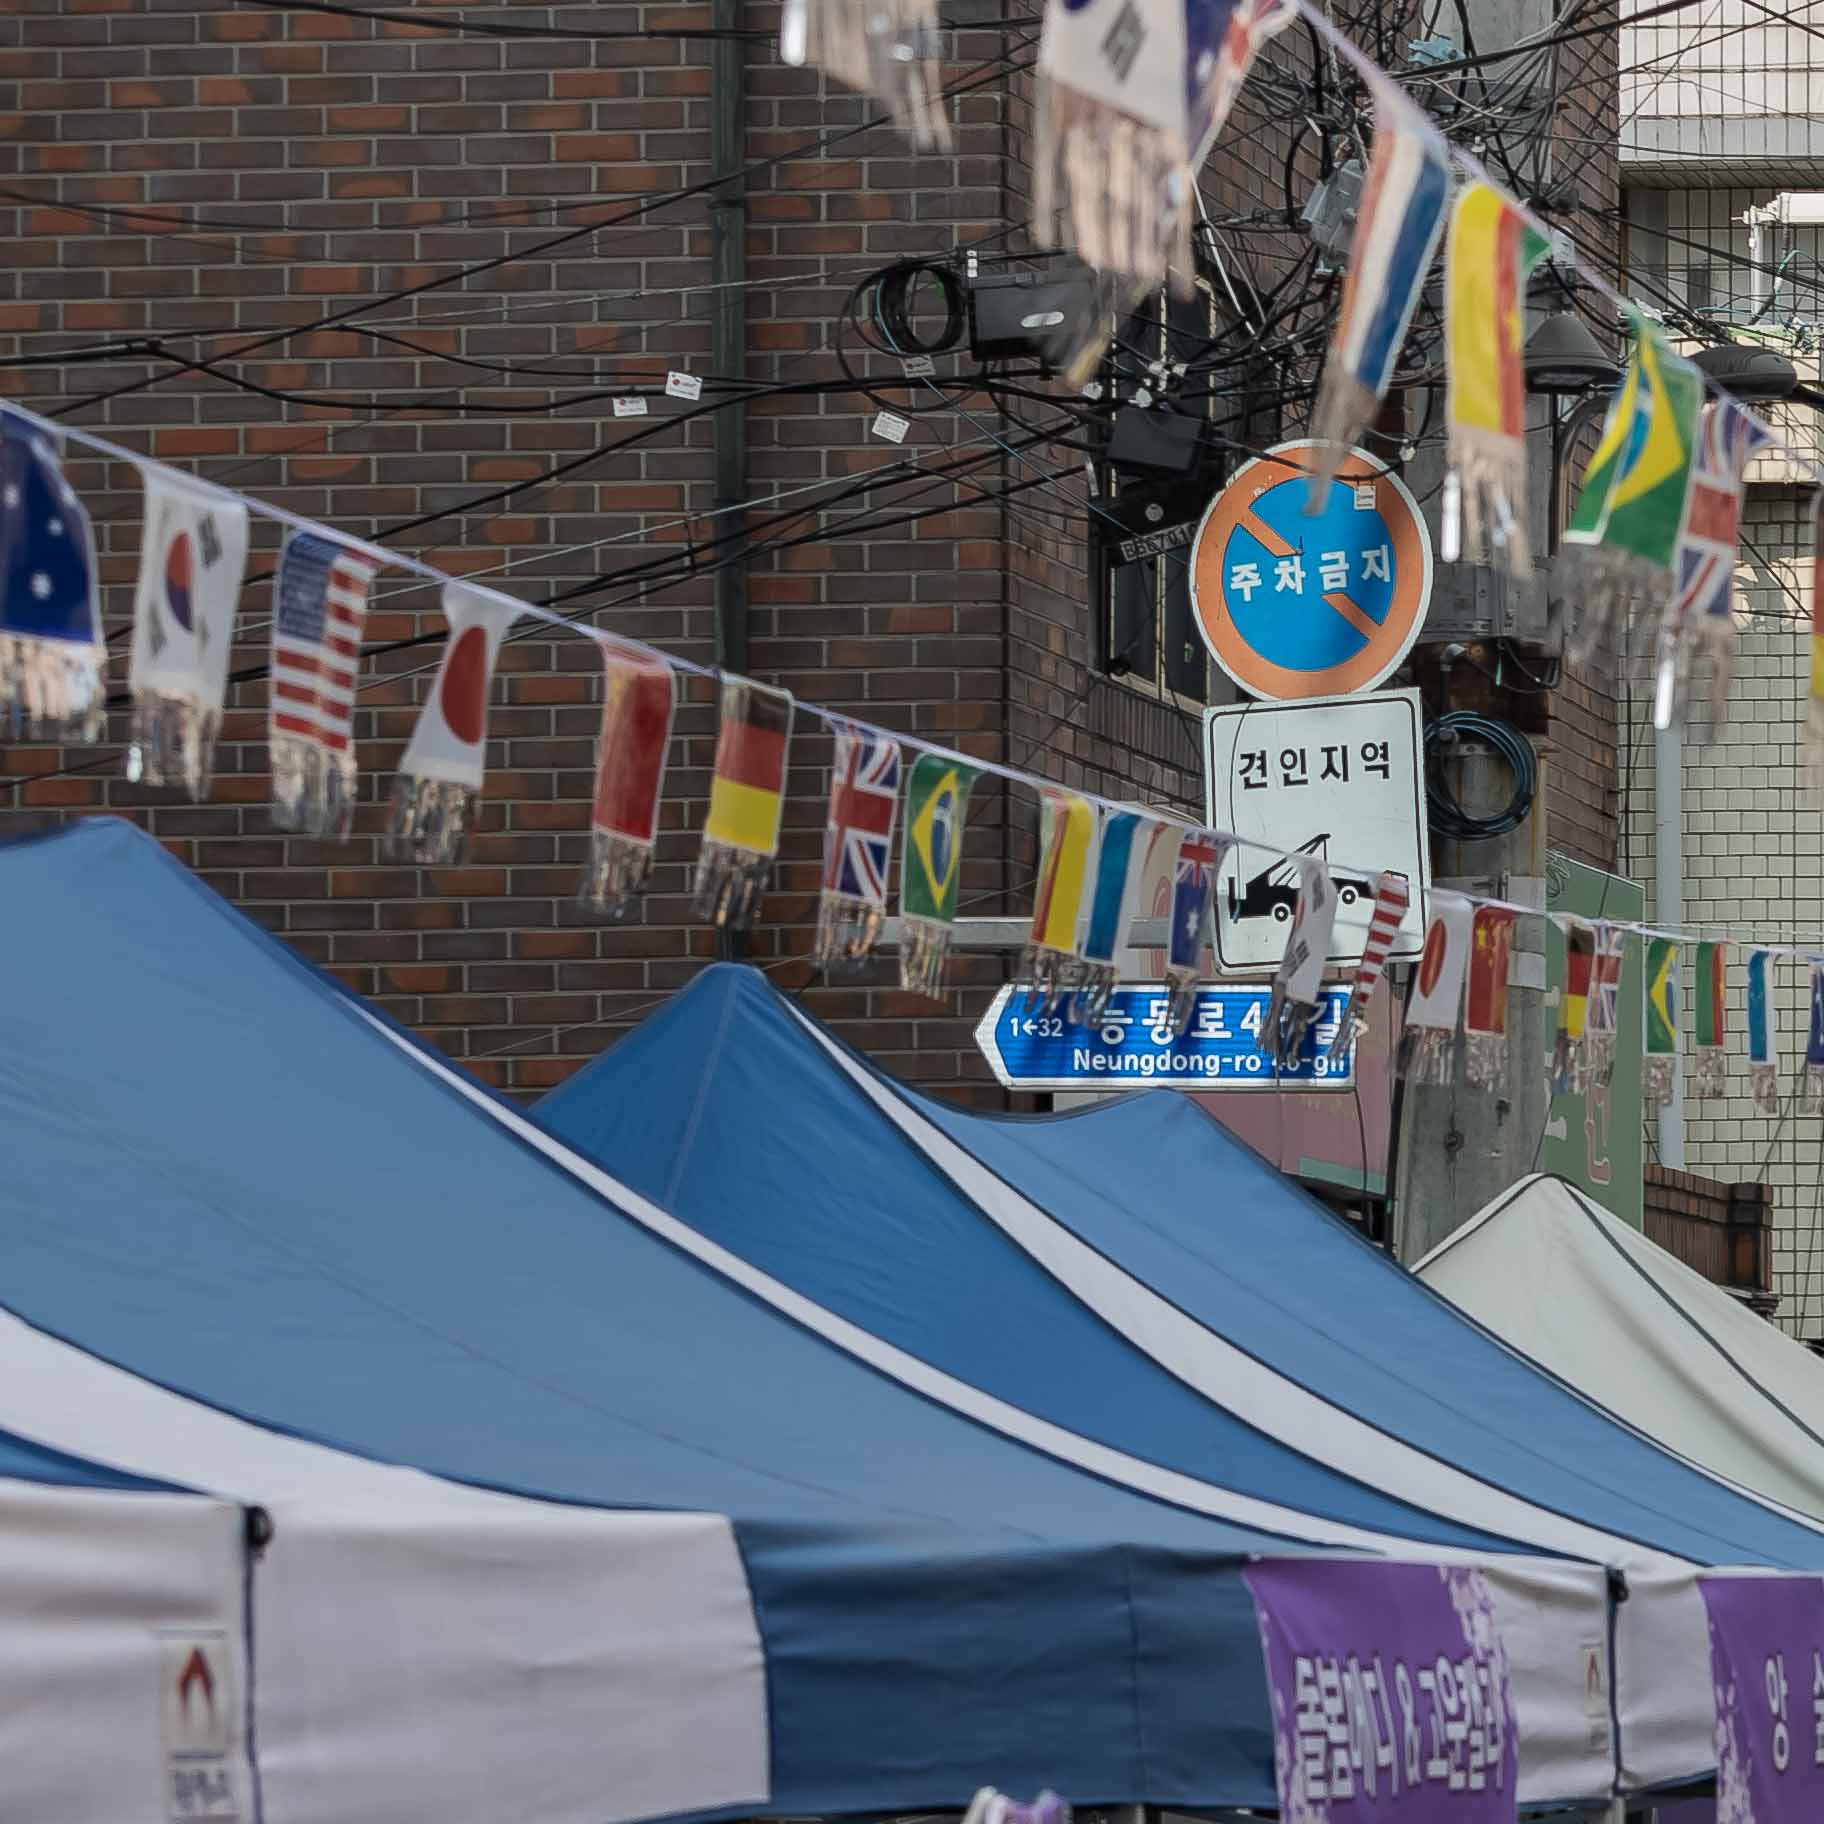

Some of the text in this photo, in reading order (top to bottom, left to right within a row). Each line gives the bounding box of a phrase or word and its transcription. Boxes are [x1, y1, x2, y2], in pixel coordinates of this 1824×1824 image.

[1230, 544, 1392, 603] 주차금지
[1238, 741, 1391, 790] 견인지역
[1073, 1048, 1262, 1076] Neungdong-ro
